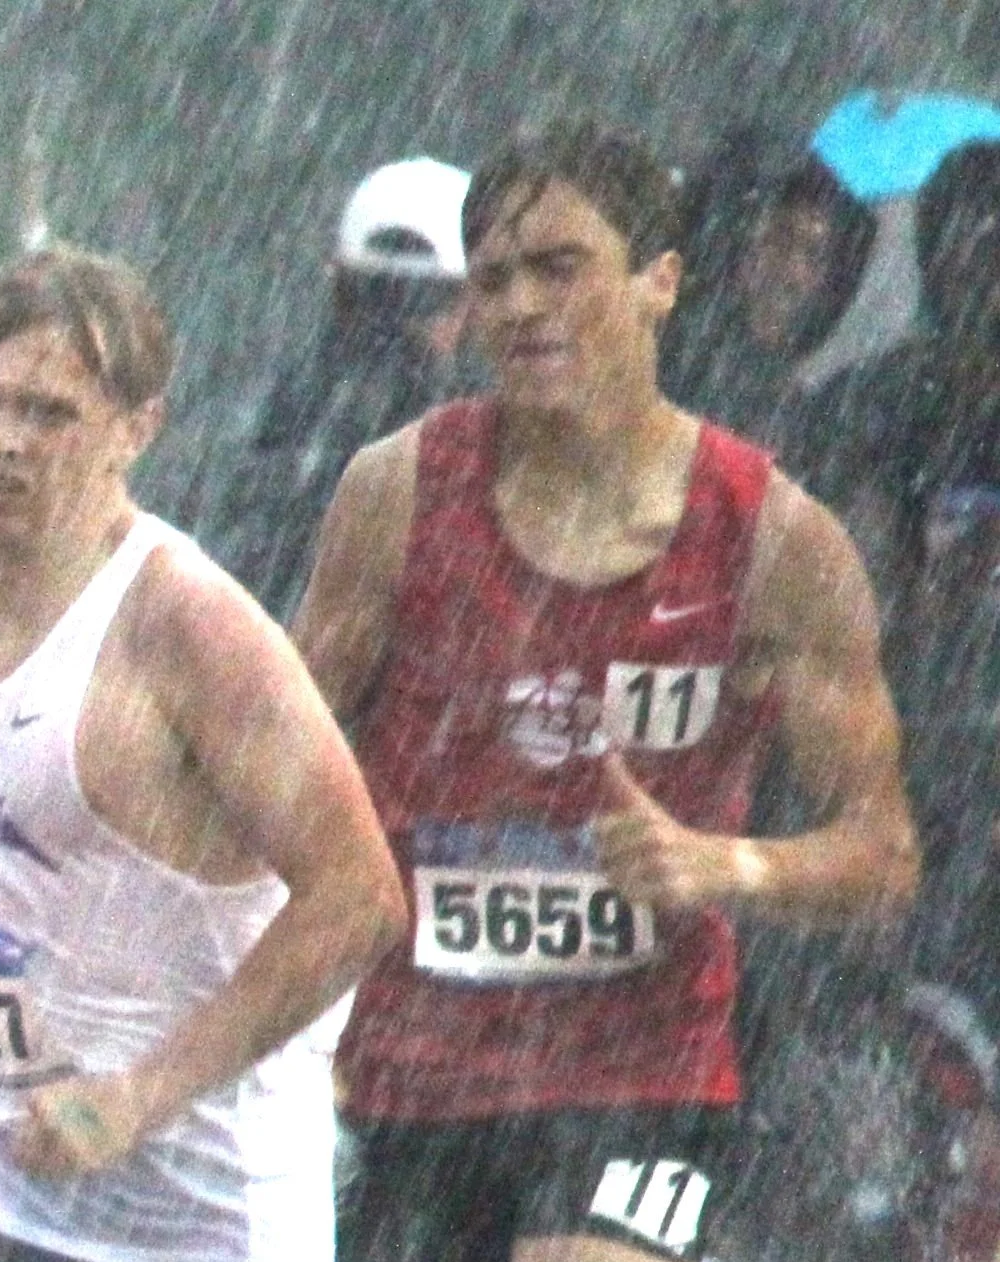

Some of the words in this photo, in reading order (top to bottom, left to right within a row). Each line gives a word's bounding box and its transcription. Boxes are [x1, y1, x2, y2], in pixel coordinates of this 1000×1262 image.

[627, 671, 696, 743] 11
[433, 884, 636, 958] 5659
[620, 1157, 693, 1240] 11
